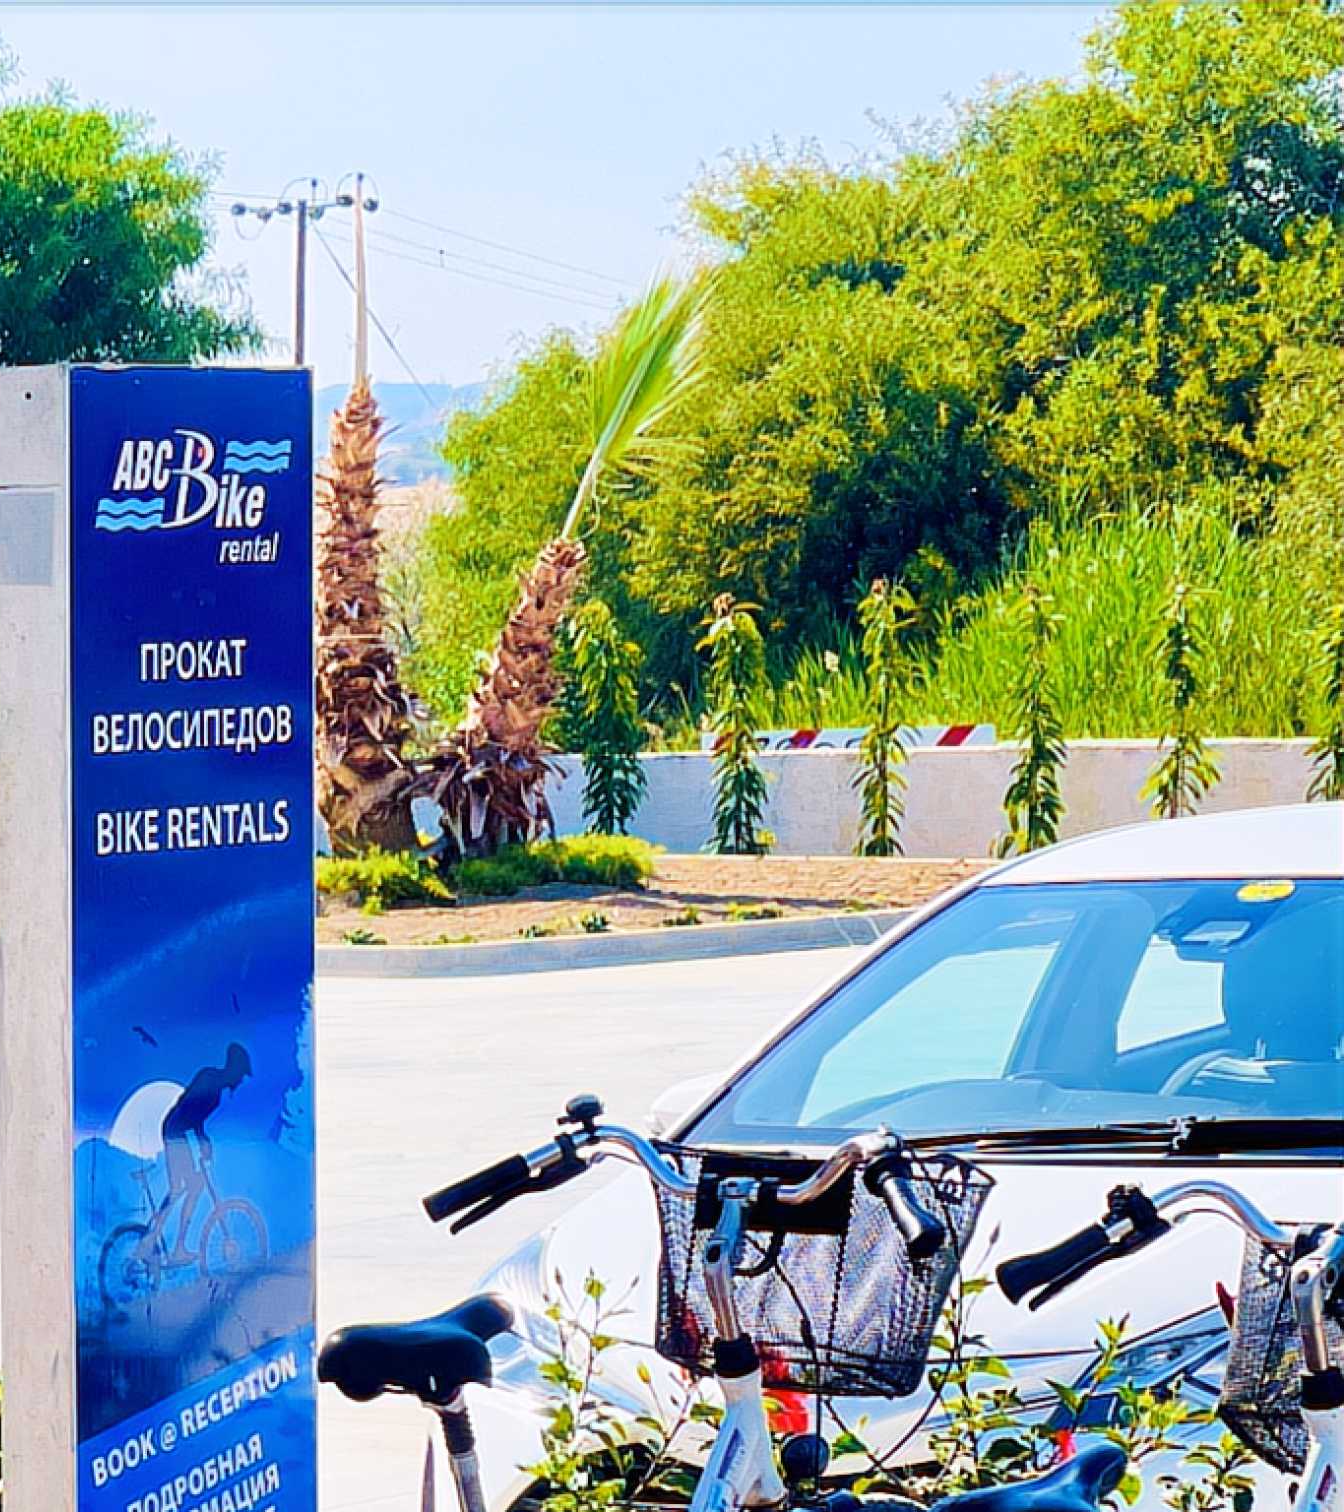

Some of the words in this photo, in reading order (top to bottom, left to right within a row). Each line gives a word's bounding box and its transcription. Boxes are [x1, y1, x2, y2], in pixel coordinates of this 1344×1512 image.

[112, 439, 173, 491] ABC
[160, 428, 266, 529] Bike
[219, 530, 280, 564] rental
[140, 638, 248, 682] ПРОКАТ
[93, 703, 293, 754] ВЕЛОСИПЕДОВ
[96, 811, 160, 856] BIKE
[167, 800, 290, 850] RENTALS
[91, 1427, 157, 1488] BOOK
[160, 1422, 179, 1452] @
[180, 1351, 299, 1438] RECEPTION
